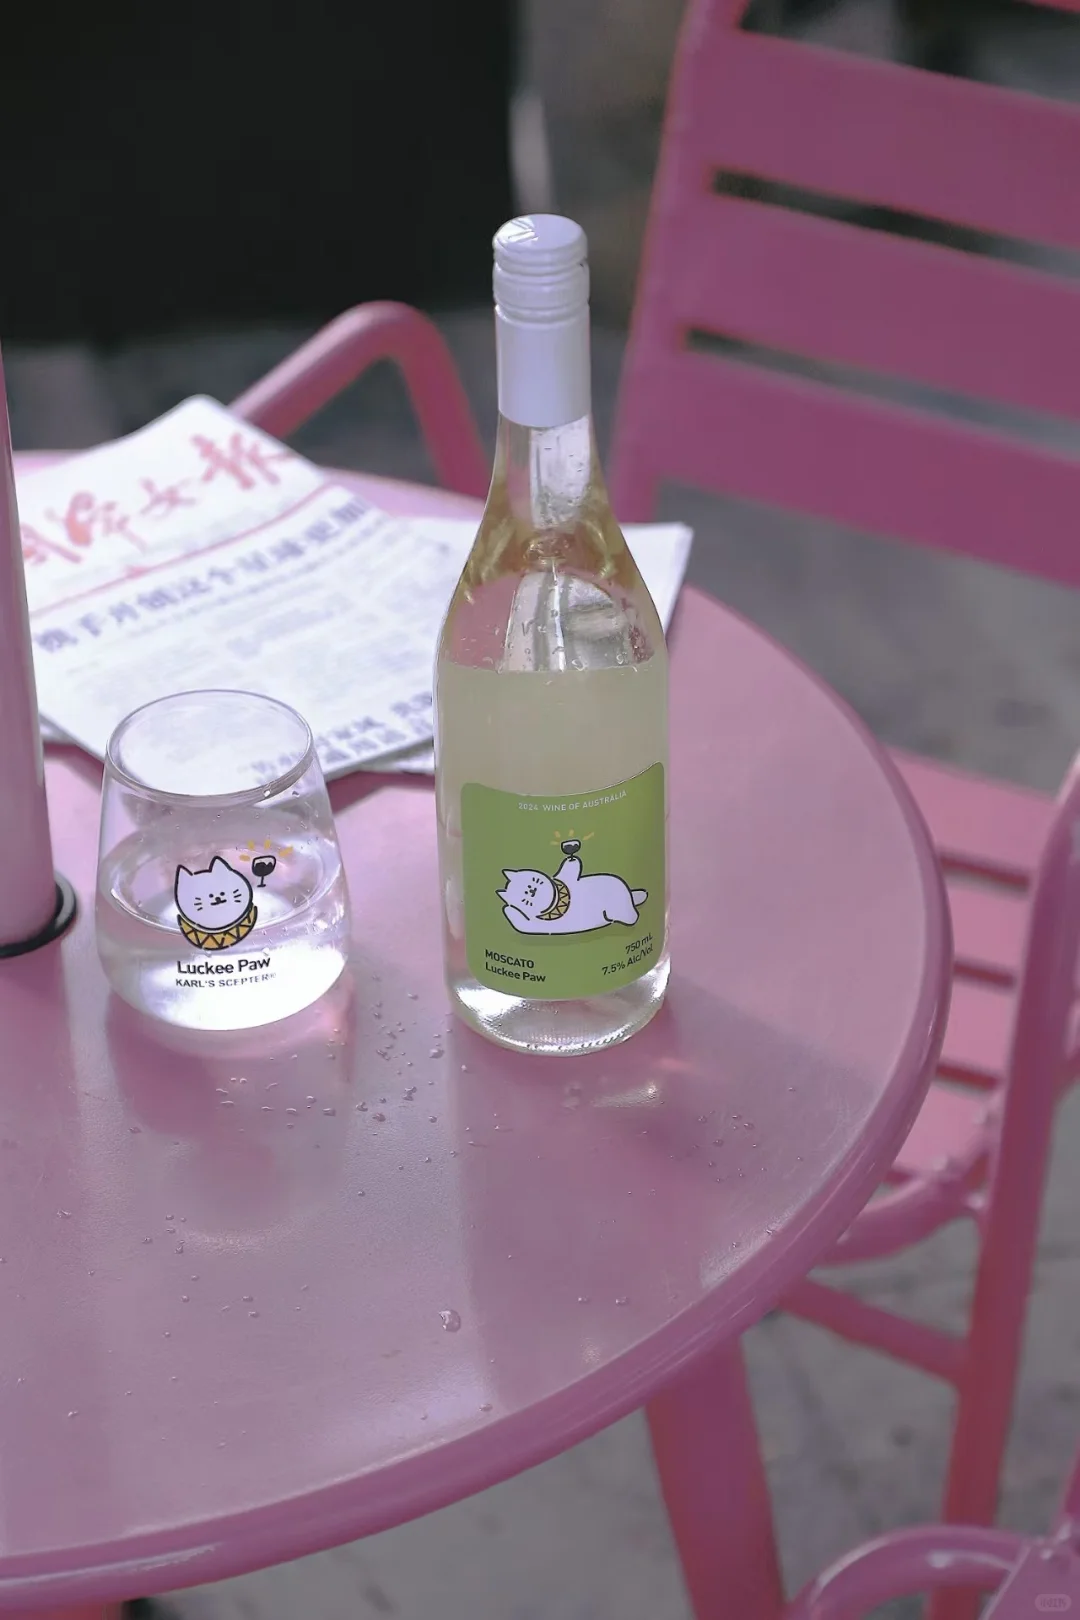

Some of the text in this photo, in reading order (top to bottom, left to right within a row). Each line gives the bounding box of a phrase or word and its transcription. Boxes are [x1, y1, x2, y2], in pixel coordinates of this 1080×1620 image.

[518, 789, 627, 812] 2024 WINE OF AUSTRALIA
[625, 932, 653, 955] 750 mL
[177, 957, 271, 975] Luckee Paw
[485, 948, 535, 969] MOSCATO
[601, 943, 653, 976] 7.5% Alc/Vol
[485, 961, 547, 982] Luckee Paw
[175, 978, 216, 988] KARL'S
